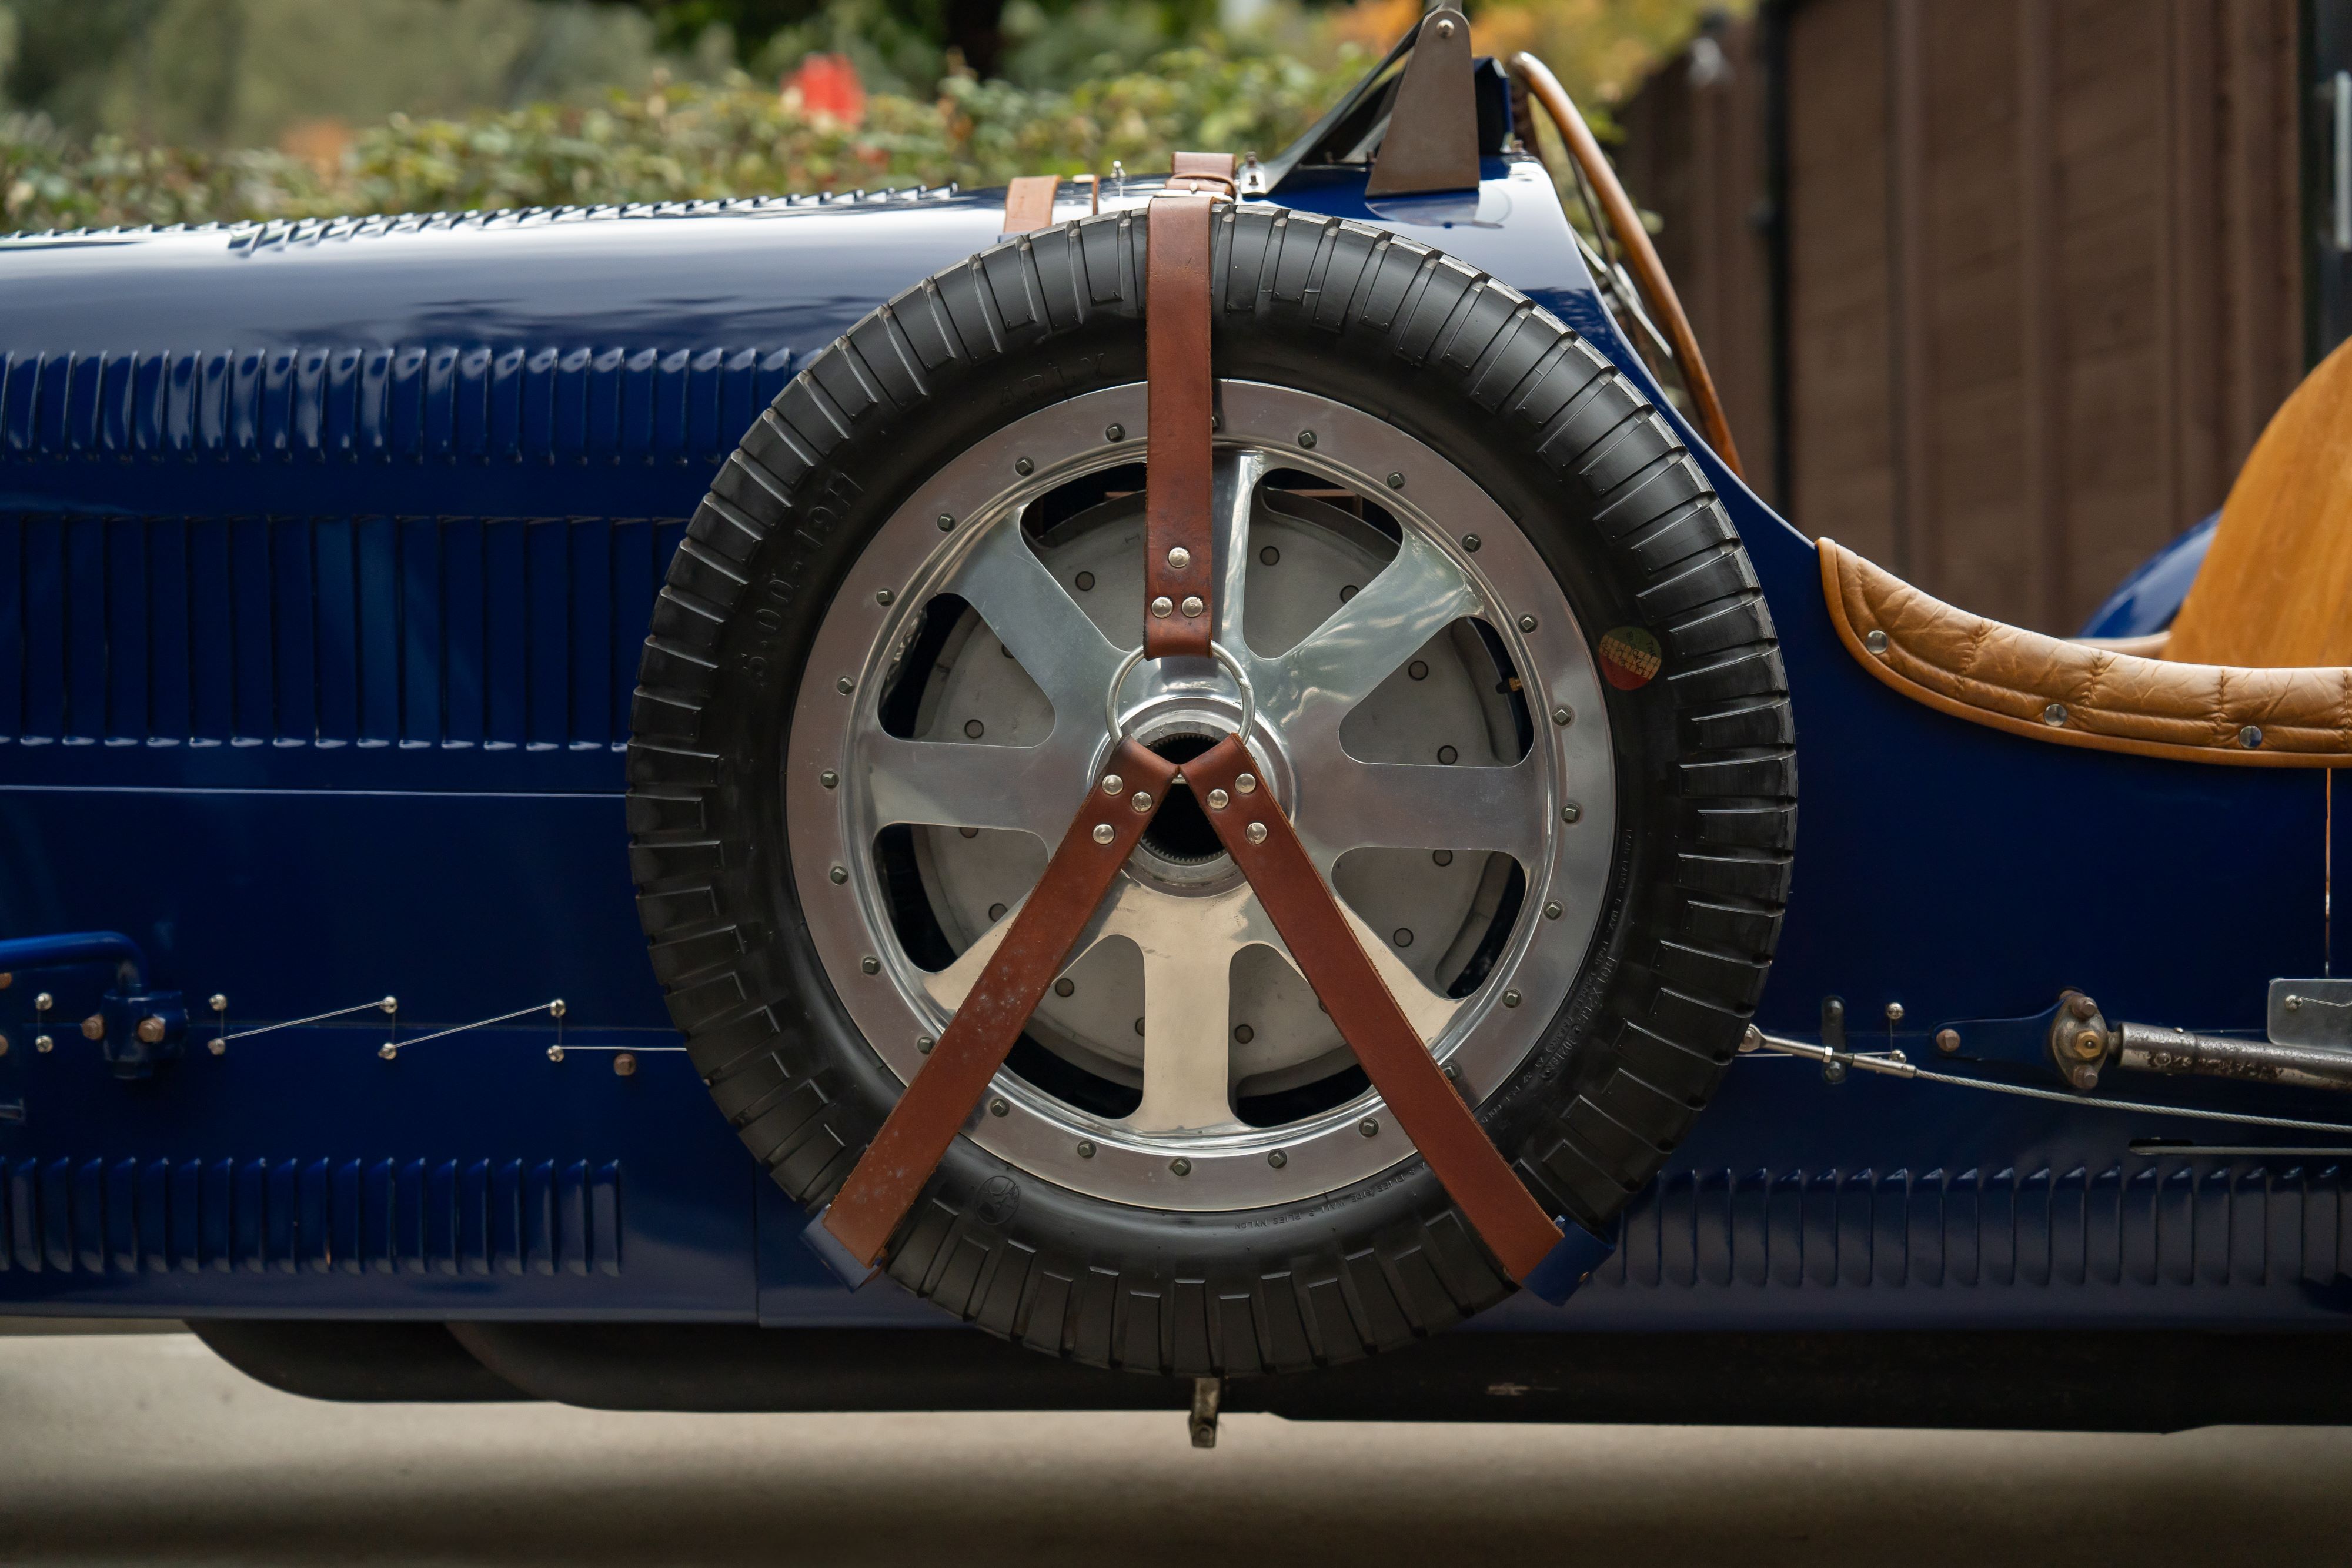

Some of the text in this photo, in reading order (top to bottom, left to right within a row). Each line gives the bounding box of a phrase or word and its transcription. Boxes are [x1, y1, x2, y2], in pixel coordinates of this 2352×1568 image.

[1626, 631, 1648, 677] BLOCKLEY
[1646, 639, 1657, 658] THE
[1505, 1086, 1521, 1102] PSI
[1480, 1104, 1502, 1125] COLD
[1377, 1174, 1405, 1193] PLIES
[1351, 1189, 1372, 1203] SIDE
[1319, 1199, 1345, 1213] WALL
[1234, 1219, 1268, 1230] NYLON
[1272, 1213, 1301, 1225] PLIES
